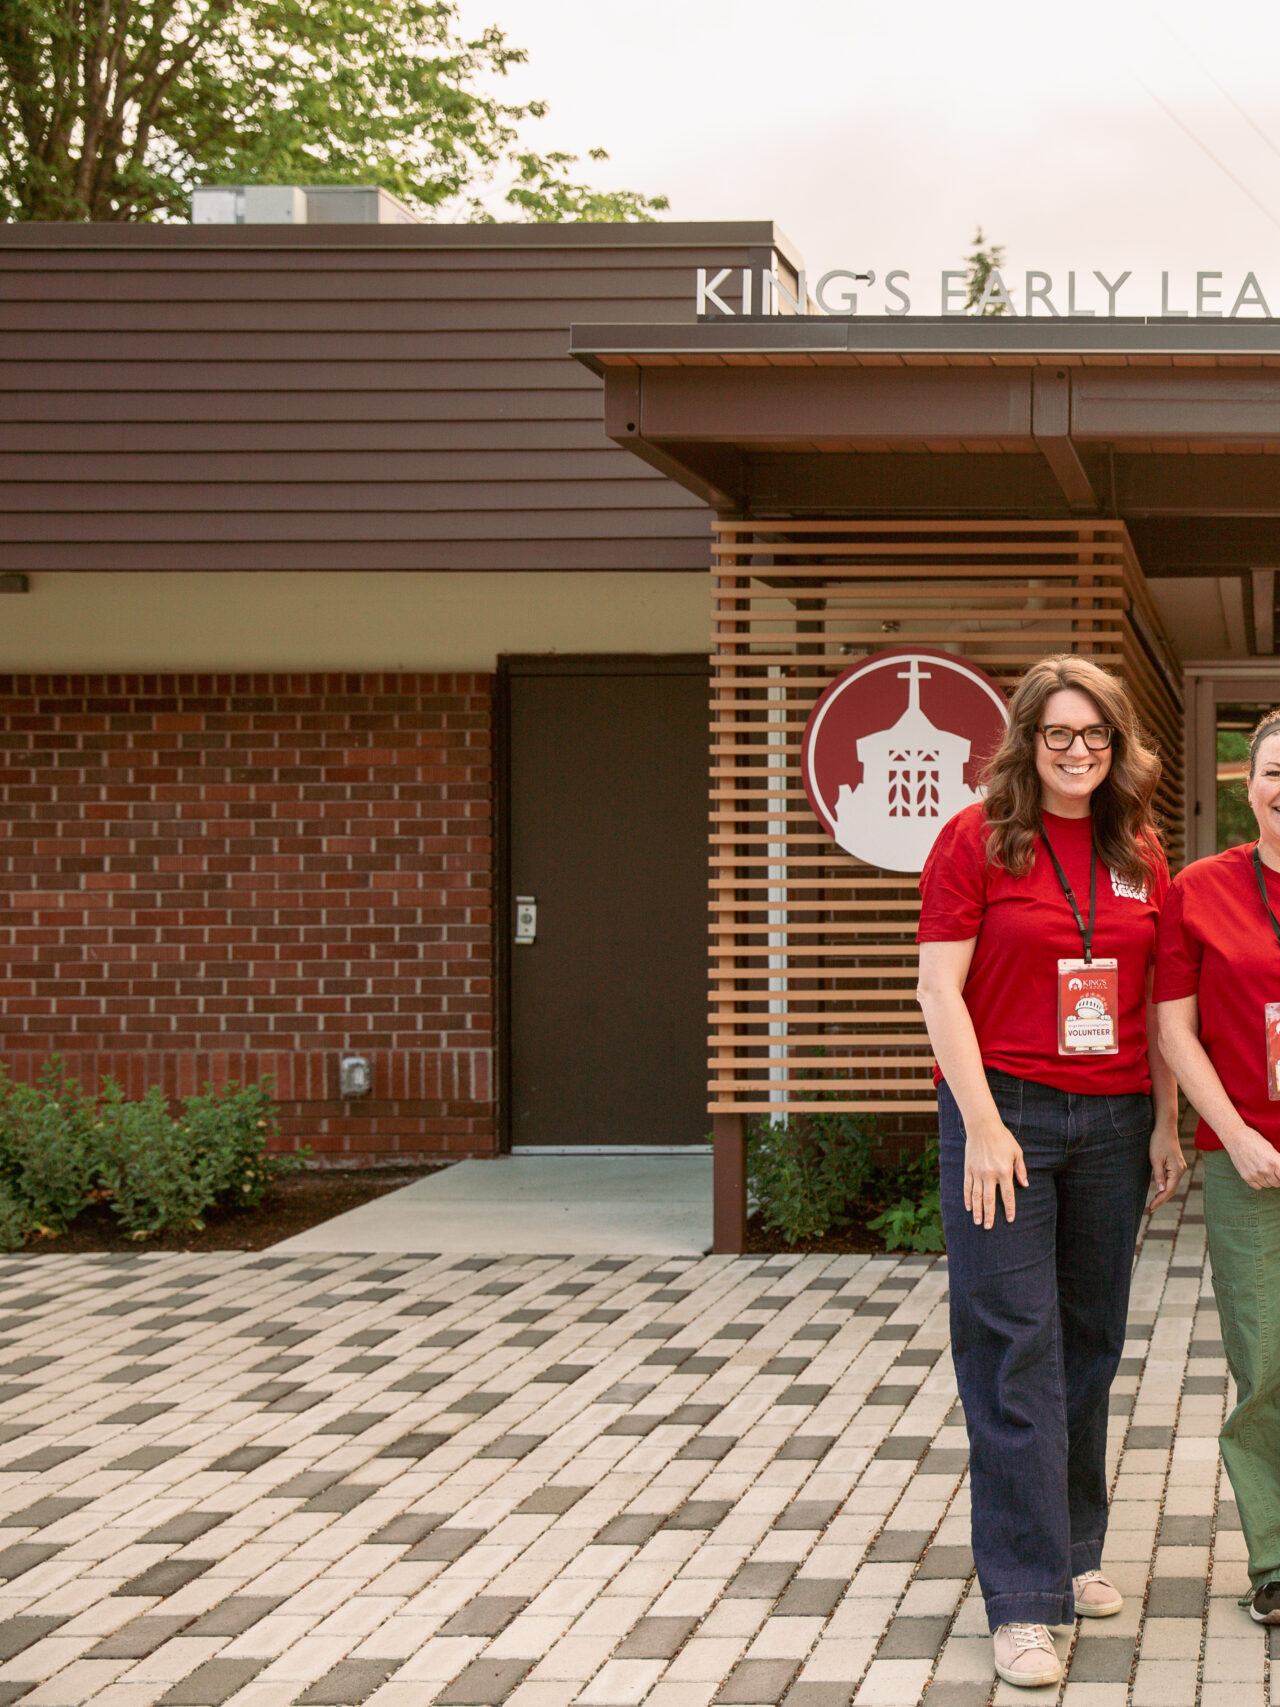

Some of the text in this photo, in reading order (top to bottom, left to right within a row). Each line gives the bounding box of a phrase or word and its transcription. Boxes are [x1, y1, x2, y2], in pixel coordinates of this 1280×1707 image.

[696, 268, 911, 316] KING'S
[941, 270, 1132, 318] EARLY
[1067, 1028, 1111, 1037] VOLUNTEER
